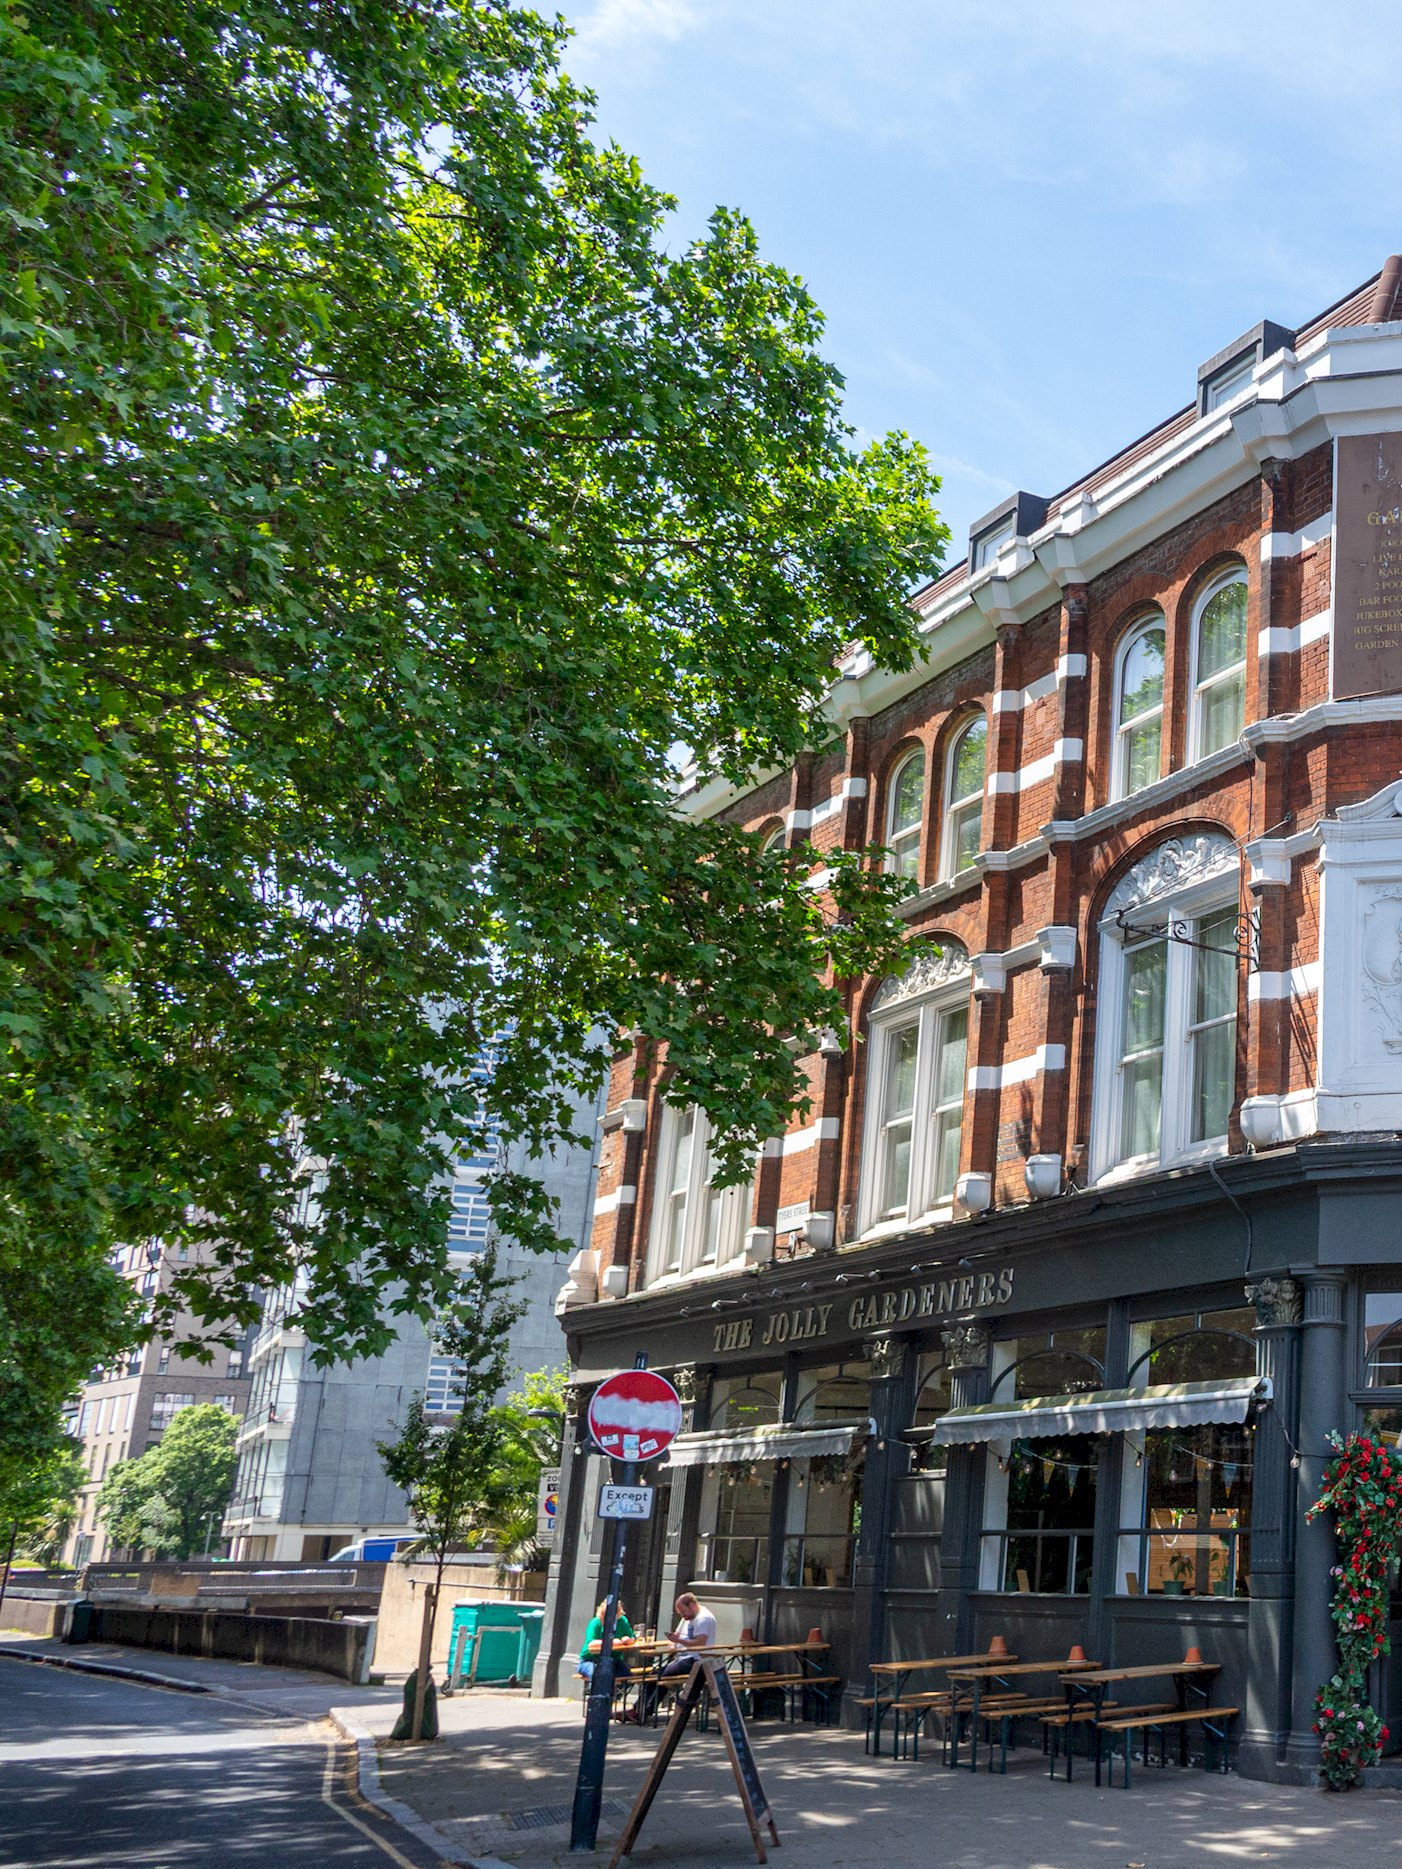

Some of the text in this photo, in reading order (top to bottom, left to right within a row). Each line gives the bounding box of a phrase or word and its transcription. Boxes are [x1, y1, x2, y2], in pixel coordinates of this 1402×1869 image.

[1373, 553, 1396, 563] LIVE
[1359, 597, 1380, 606] BAR
[1355, 609, 1402, 621] JUKEBOX
[1353, 625, 1372, 635] BIG
[1355, 639, 1399, 650] GARDEN
[713, 1268, 1015, 1353] THE JOLLY GARDENERS
[607, 1490, 648, 1502] Except
